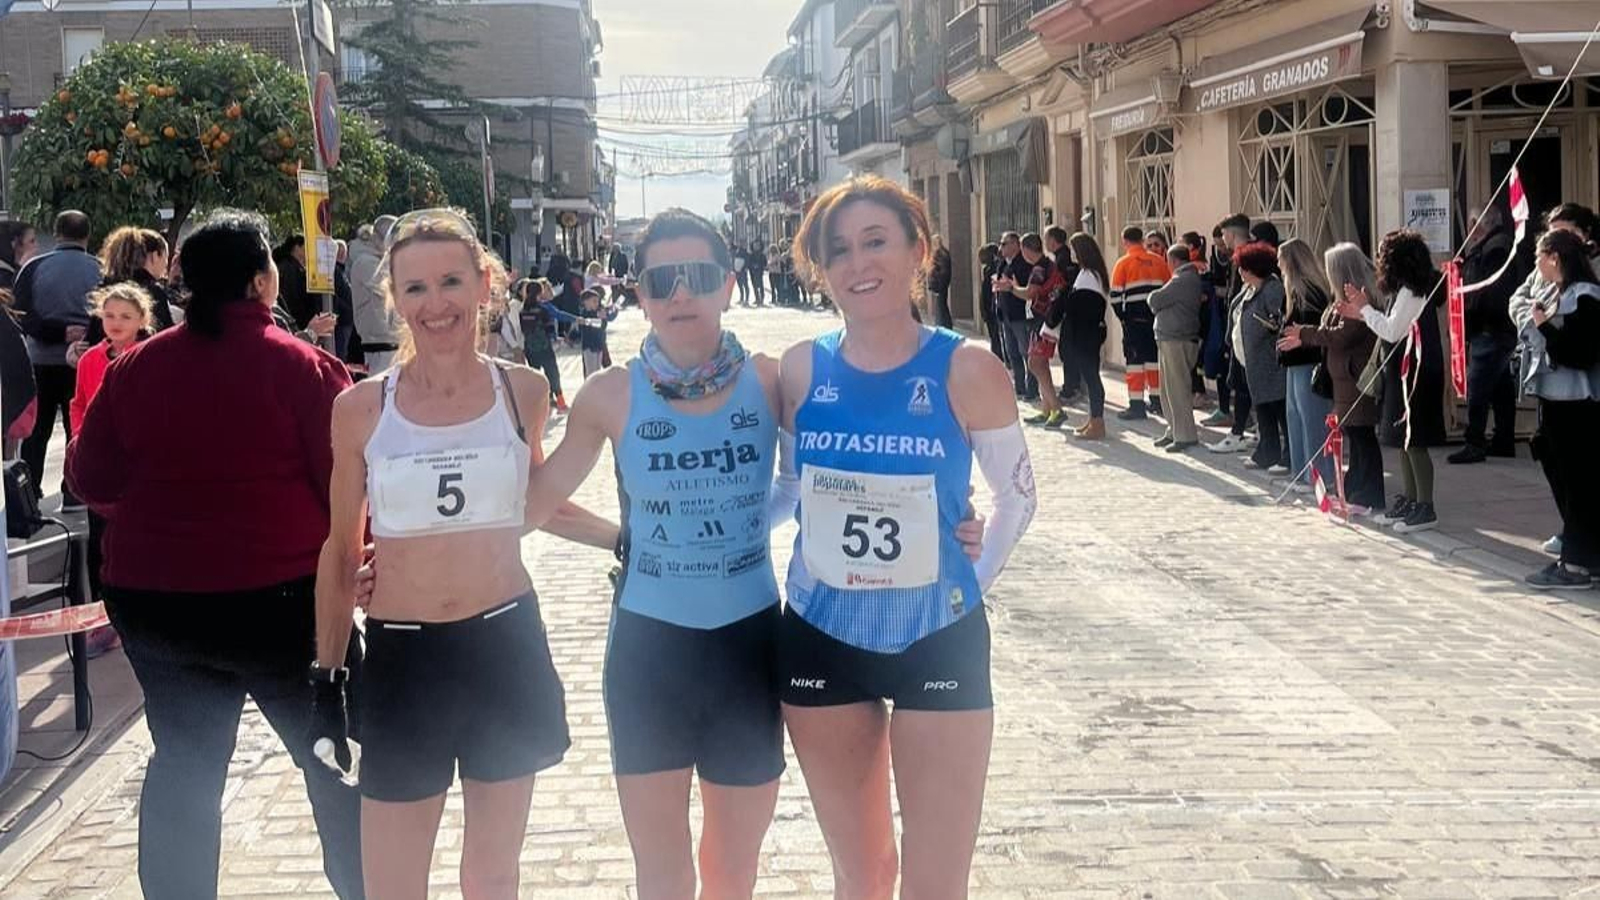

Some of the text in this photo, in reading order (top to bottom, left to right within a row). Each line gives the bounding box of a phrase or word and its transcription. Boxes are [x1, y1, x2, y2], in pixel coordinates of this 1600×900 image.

[1201, 56, 1329, 108] CAFETERÍA GRANADOS
[639, 421, 675, 438] TROPS
[799, 431, 946, 459] TROTASIERRA
[648, 440, 760, 474] nerja
[666, 474, 750, 492] ATLETISMO
[437, 473, 466, 517] 5
[842, 513, 902, 562] 53
[683, 559, 719, 573] activa
[790, 677, 826, 690] NIKE
[923, 680, 959, 691] PRO
